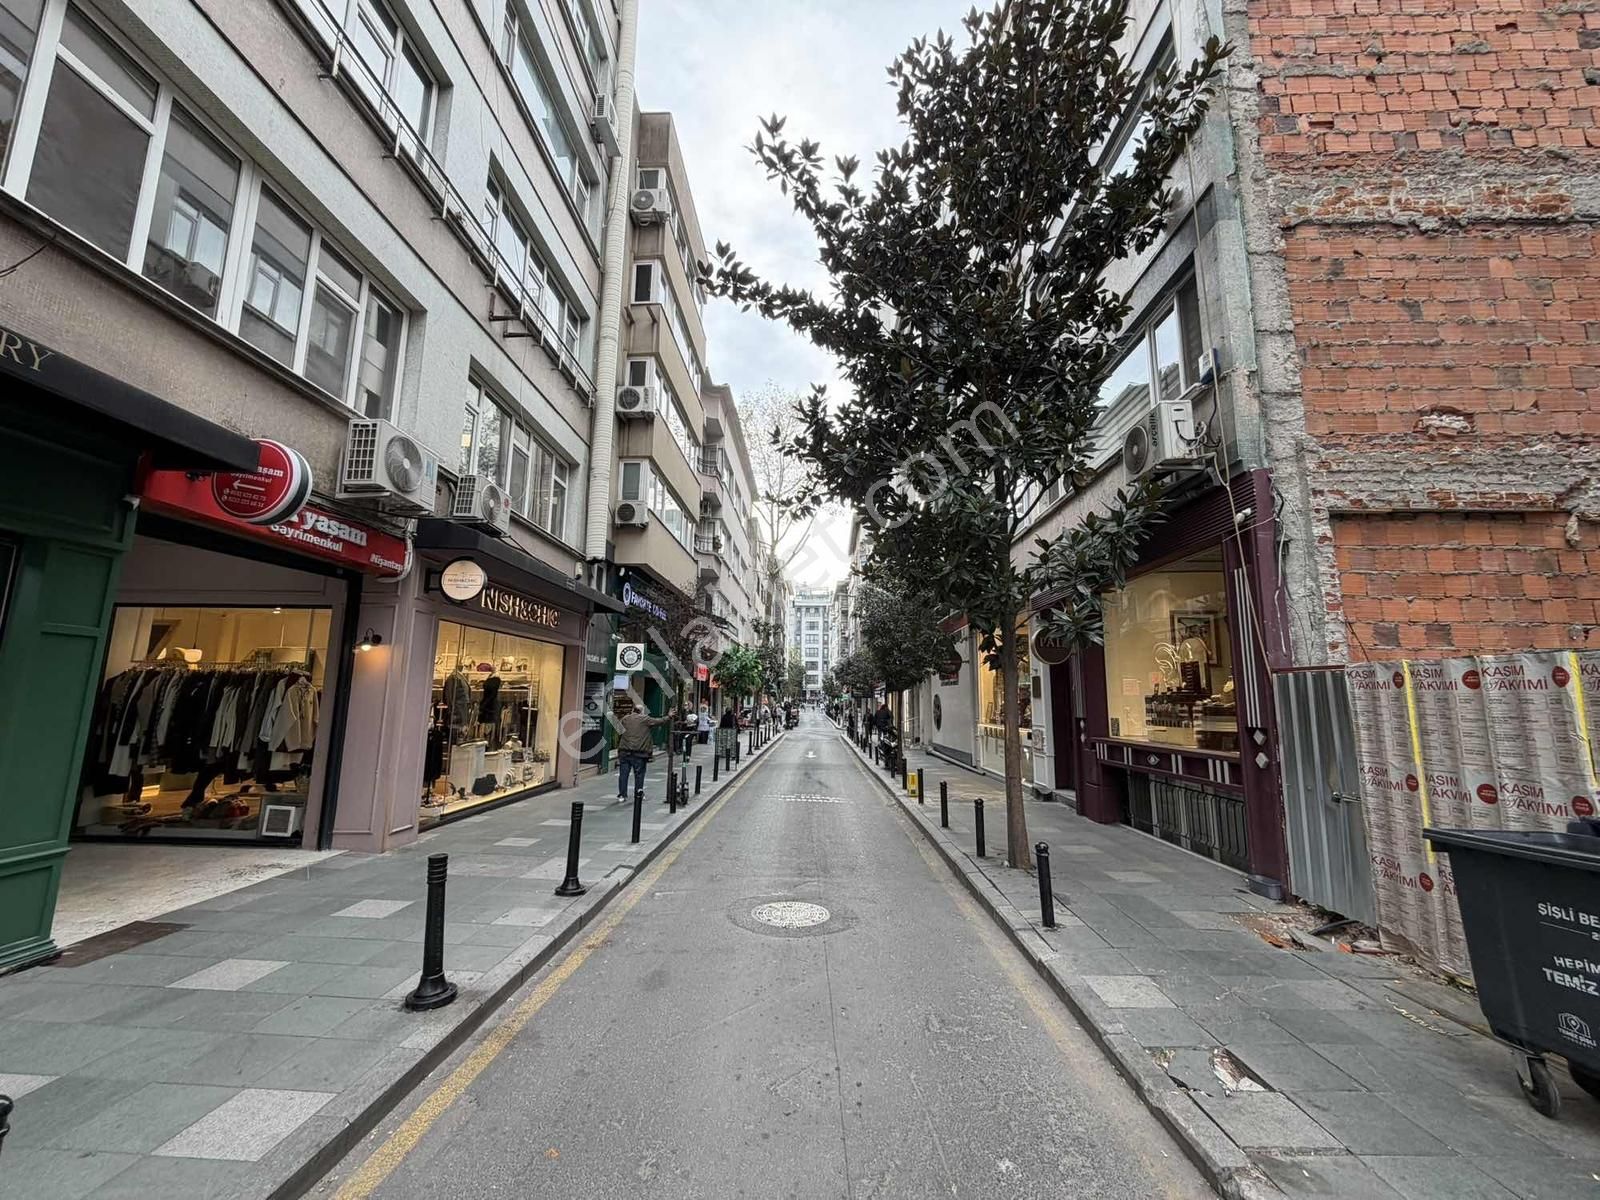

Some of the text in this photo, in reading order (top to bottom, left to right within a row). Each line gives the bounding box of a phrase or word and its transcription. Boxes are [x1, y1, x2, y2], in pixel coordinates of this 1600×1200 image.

[302, 511, 367, 546] yaşam
[481, 588, 561, 628] NISH&CHIC
[1481, 665, 1525, 677] KASIM
[1426, 774, 1460, 787] ASIM
[1499, 782, 1544, 799] KASIM
